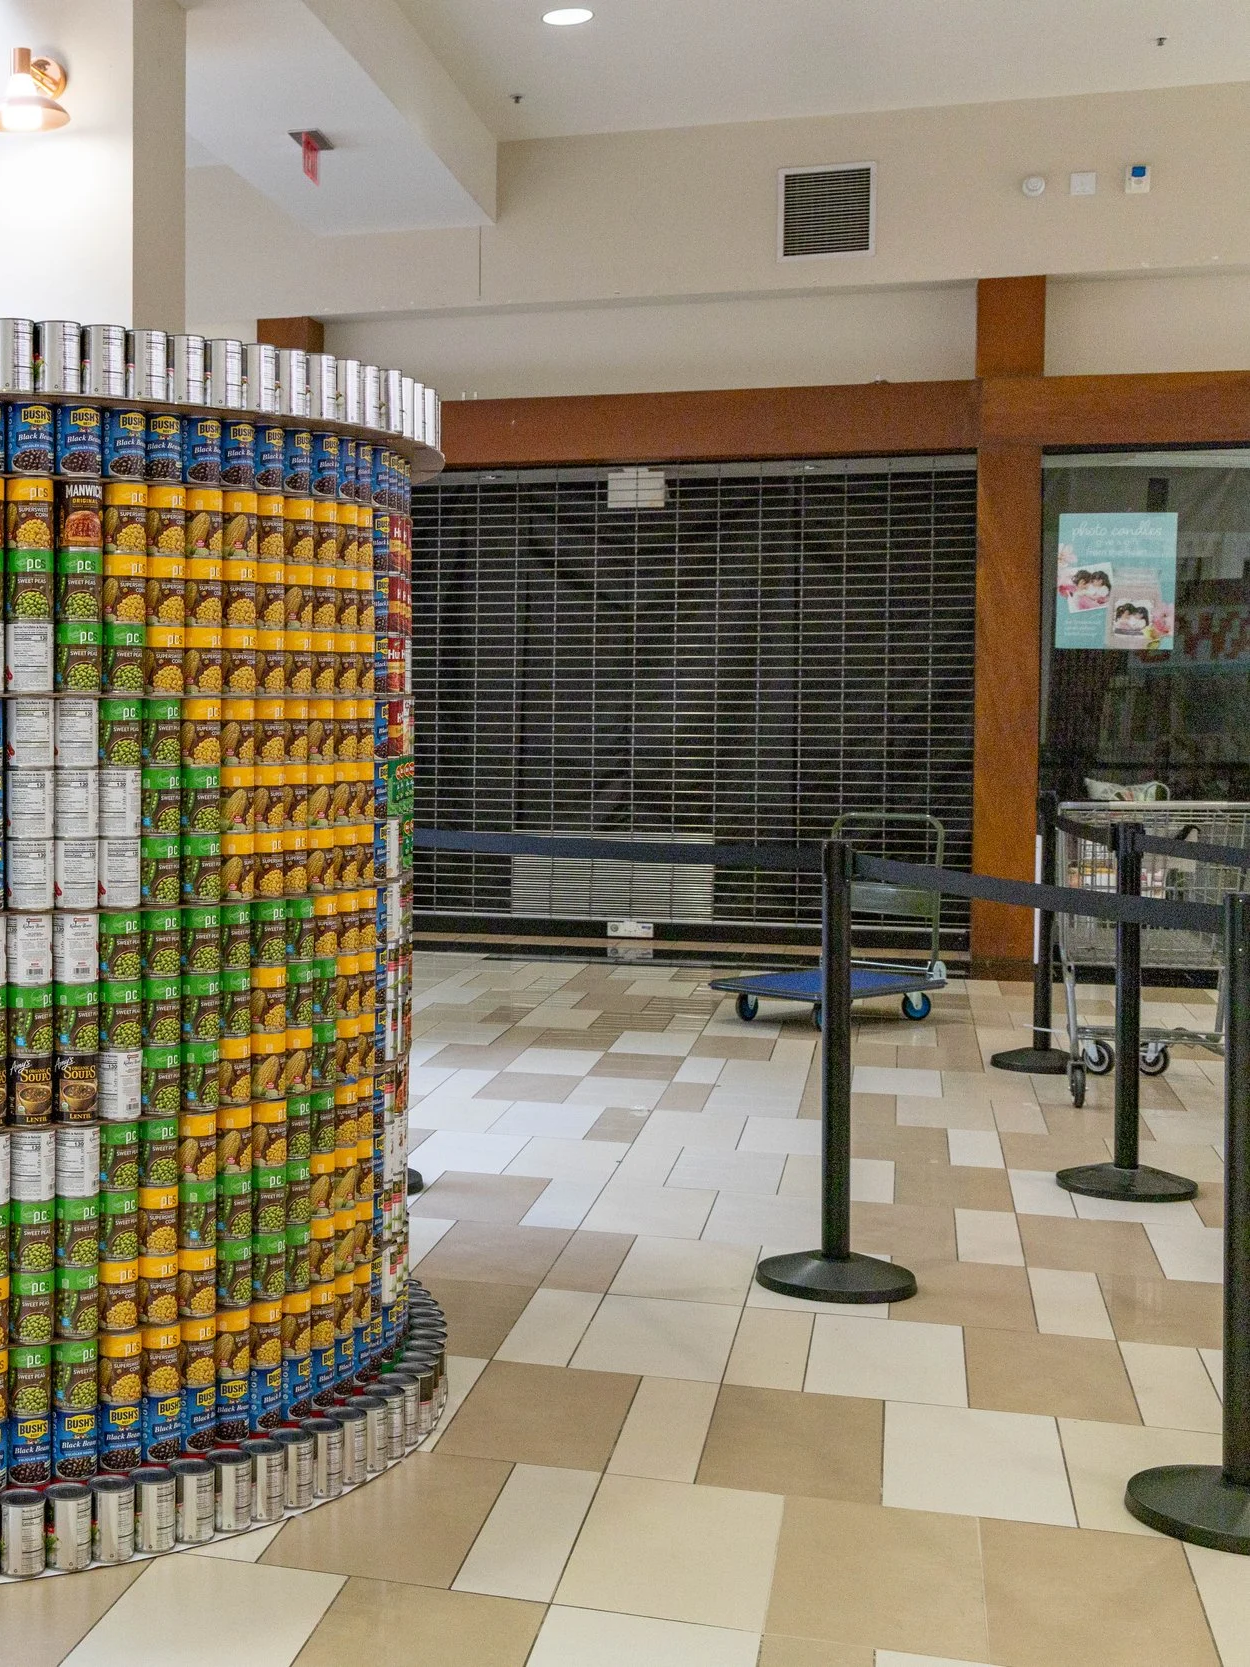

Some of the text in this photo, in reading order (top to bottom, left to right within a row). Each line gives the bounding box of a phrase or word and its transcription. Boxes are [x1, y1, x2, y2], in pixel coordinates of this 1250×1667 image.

[151, 419, 179, 429] BUSH'S
[10, 1060, 31, 1075] Amy's
[55, 1057, 75, 1072] Amy's
[20, 1068, 52, 1082] SOUPS
[63, 1065, 96, 1079] SOUPS
[221, 1384, 247, 1395] BUSH'S
[111, 1409, 139, 1421] BUSH'S
[67, 1417, 95, 1429] BUSH'S
